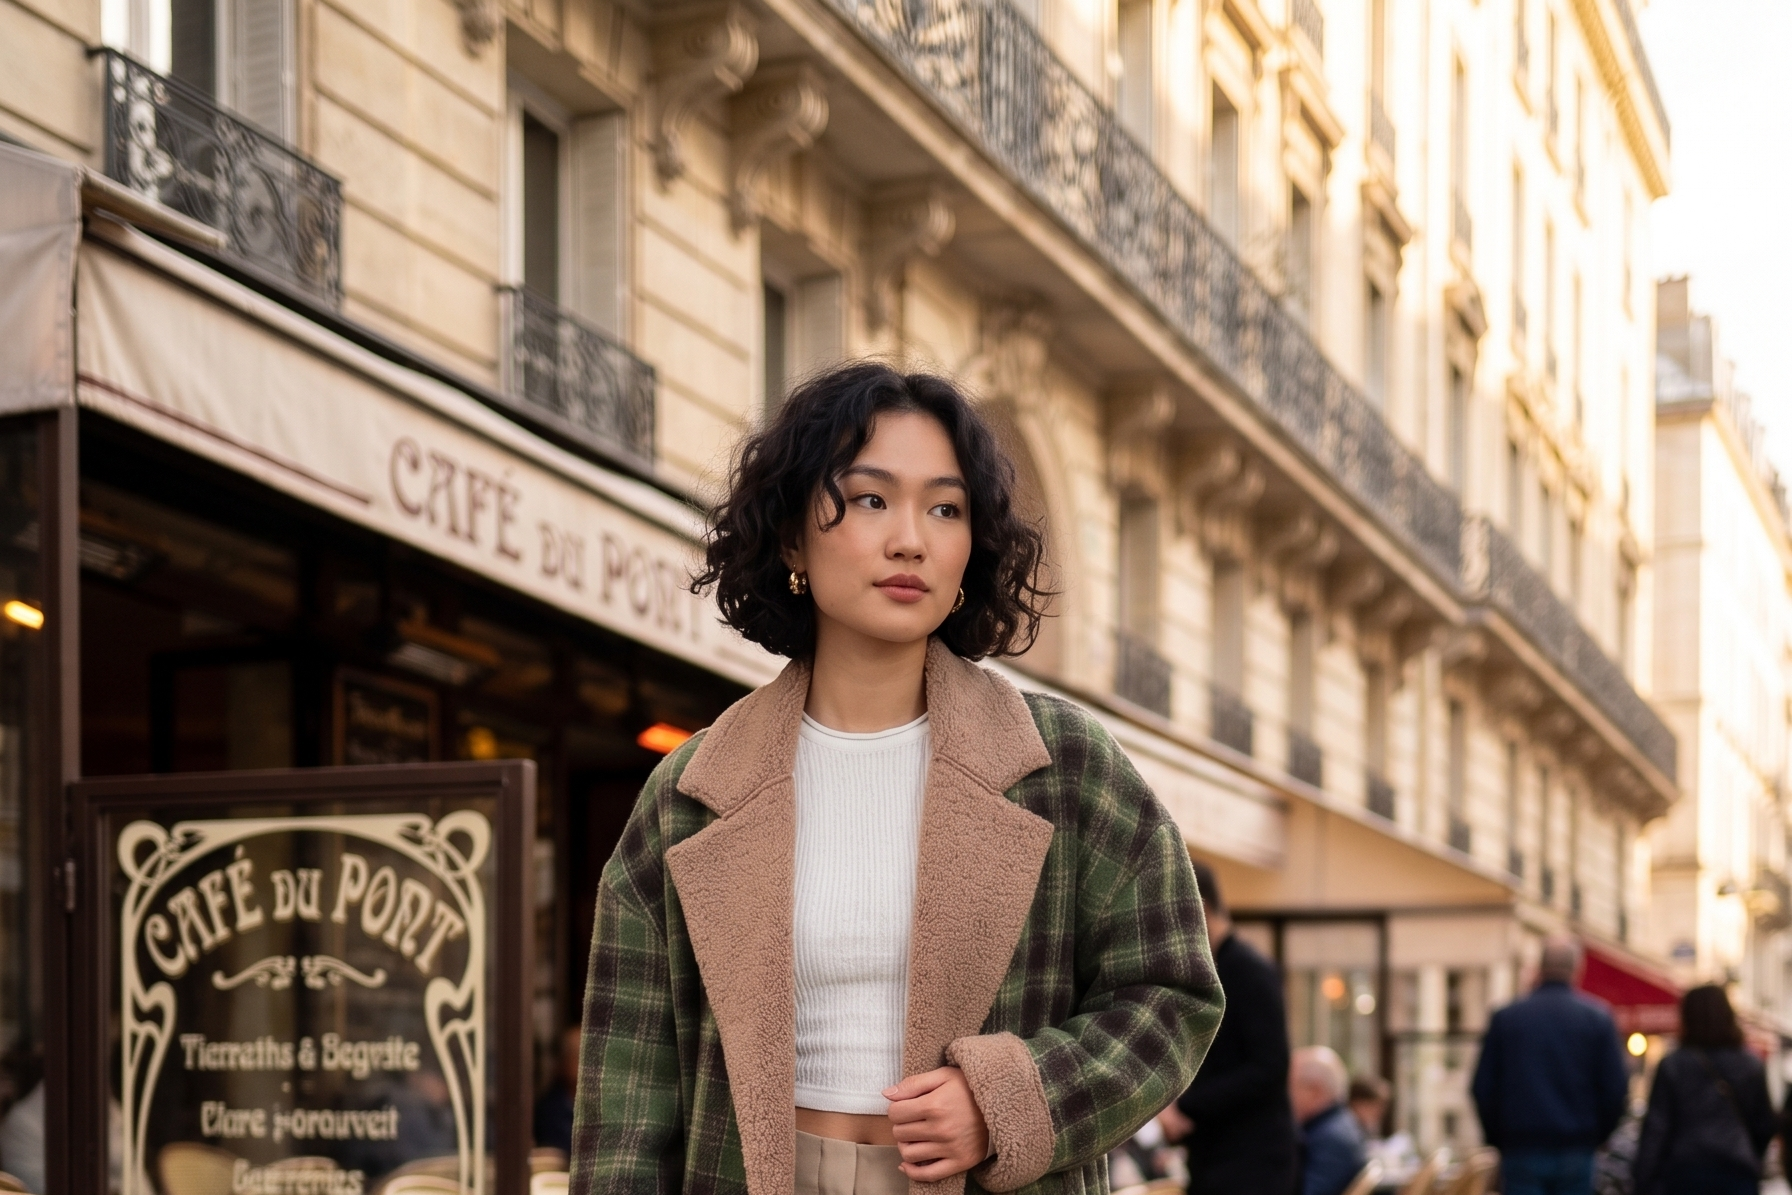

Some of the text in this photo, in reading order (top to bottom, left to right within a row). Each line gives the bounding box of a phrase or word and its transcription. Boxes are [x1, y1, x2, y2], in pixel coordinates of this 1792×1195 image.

[389, 436, 521, 562] CAFÉ
[537, 520, 587, 592] DU
[144, 844, 466, 977] CAFÉ DU PONT
